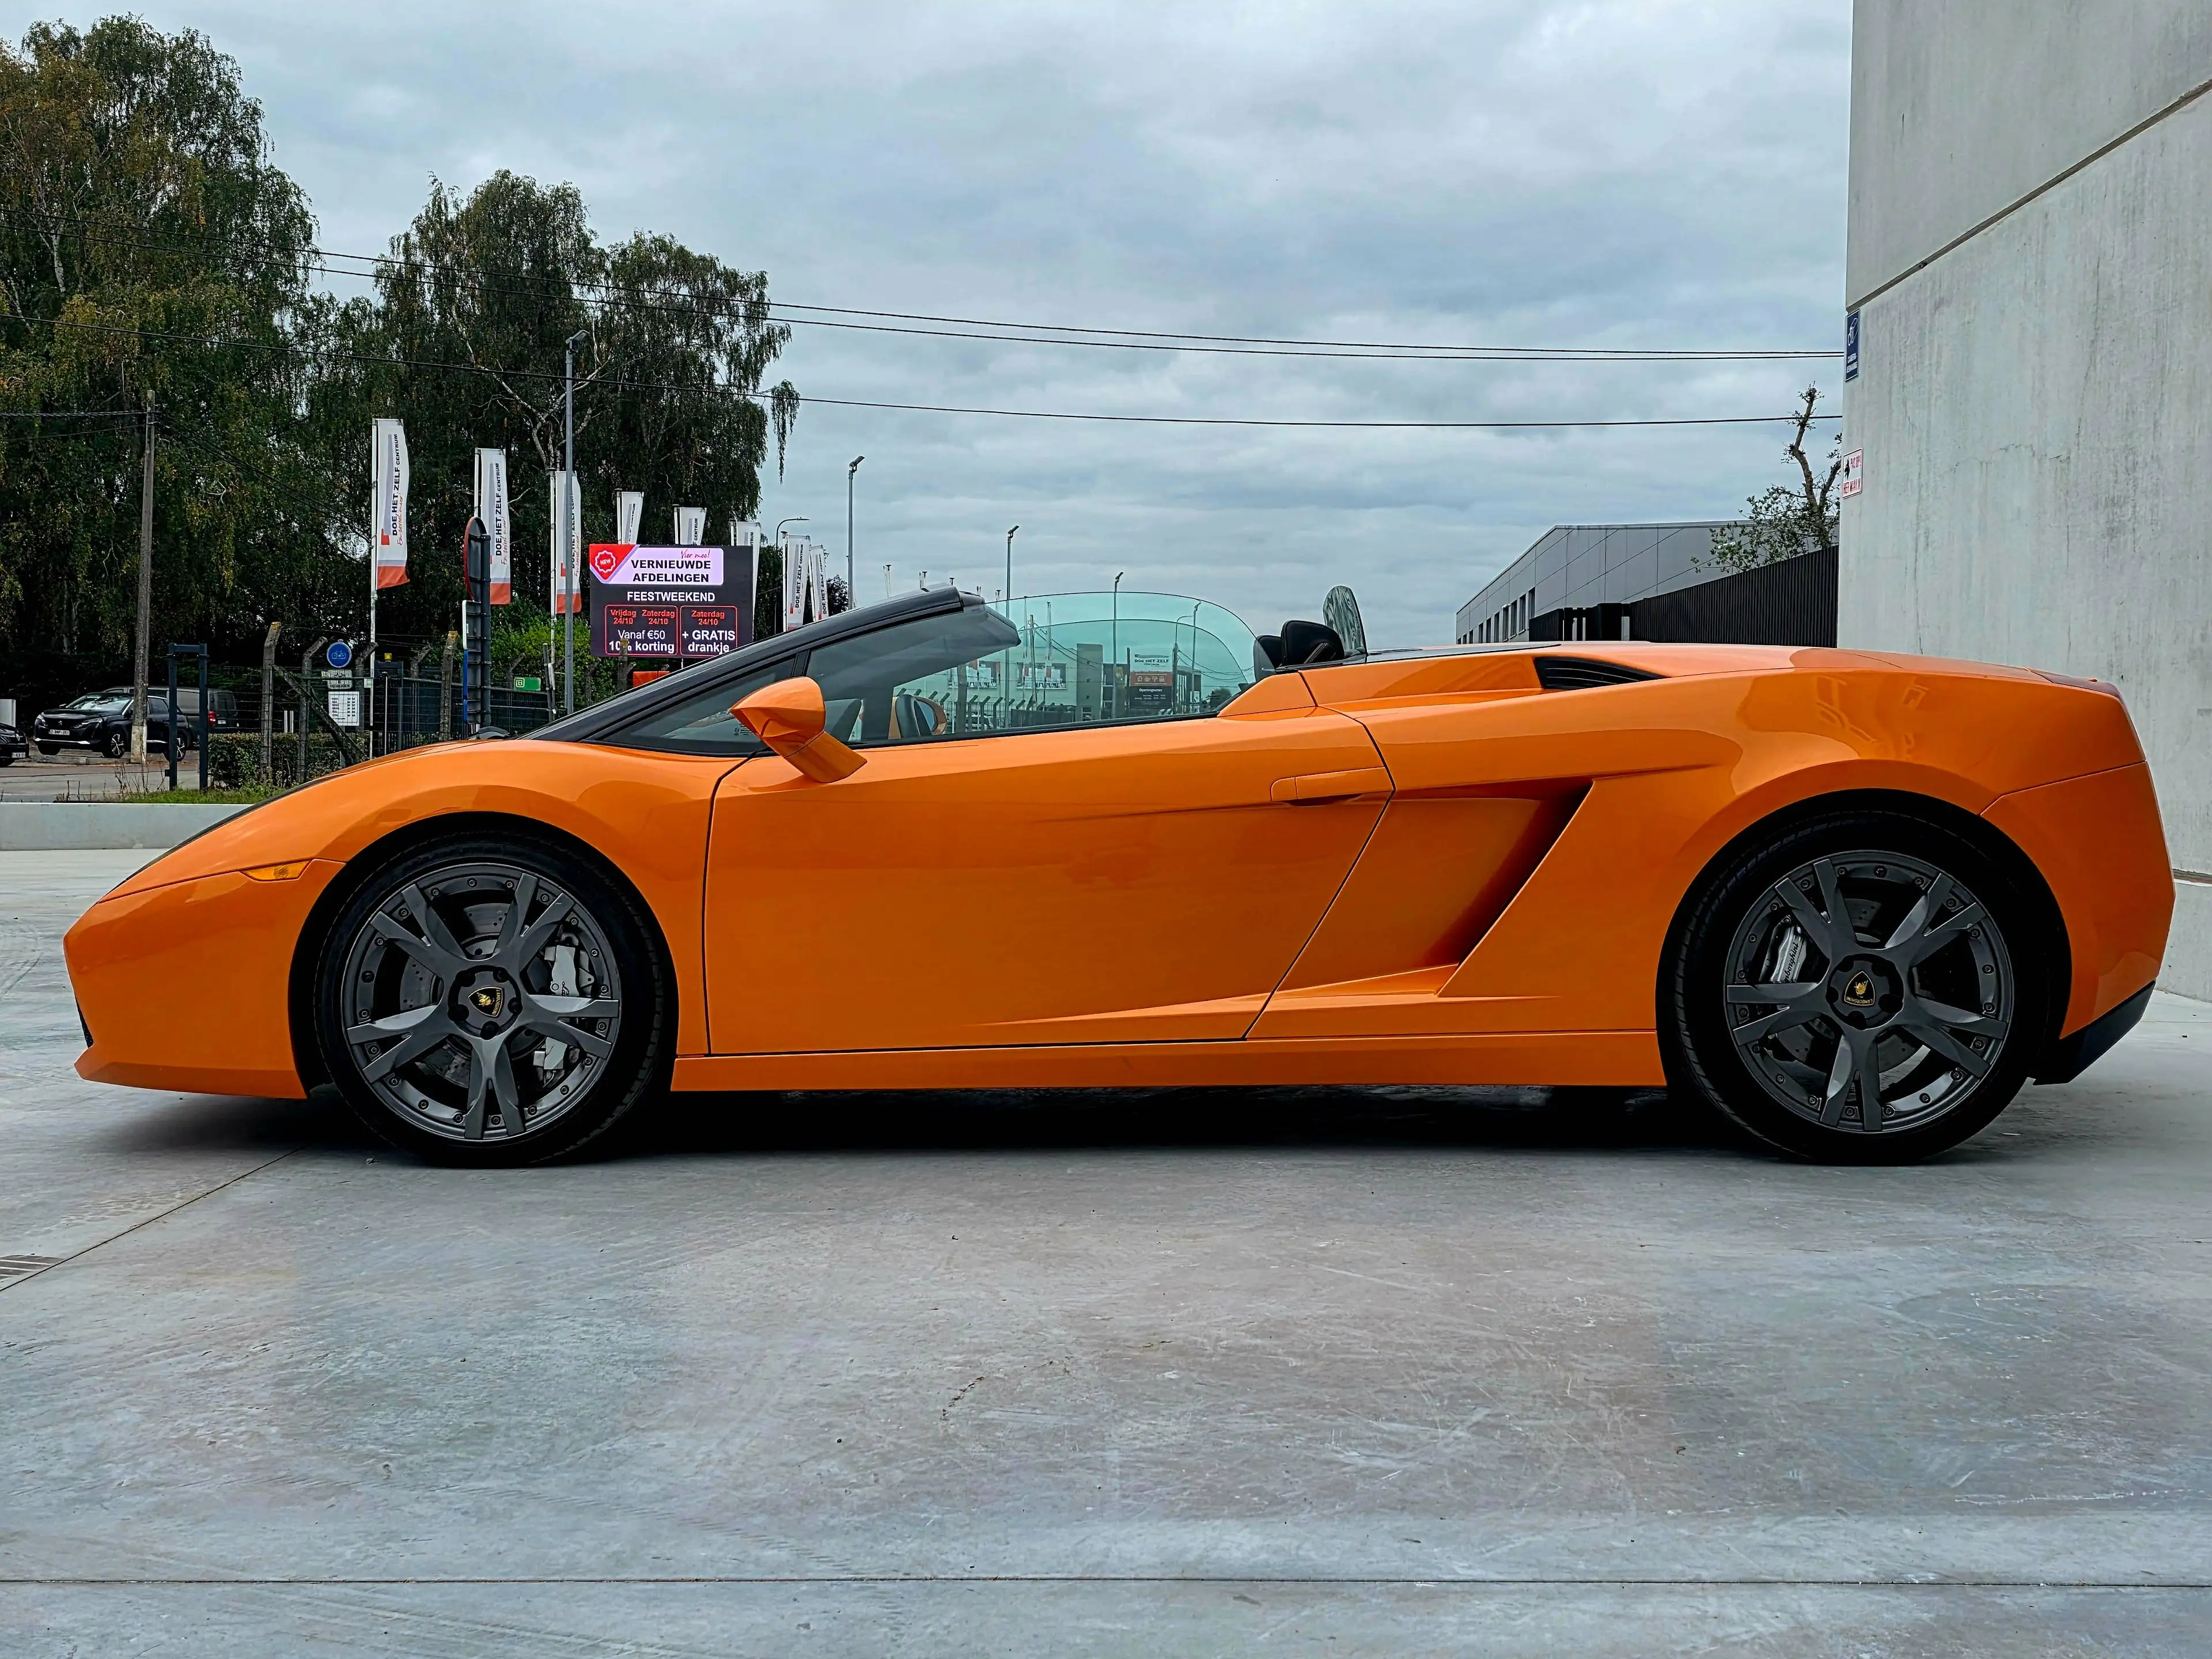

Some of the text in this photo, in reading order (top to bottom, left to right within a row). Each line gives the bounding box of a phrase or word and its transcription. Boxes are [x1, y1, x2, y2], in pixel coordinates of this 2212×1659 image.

[631, 560, 711, 569] VERNIEUWDE
[633, 573, 709, 582] AFDELINGEN
[627, 592, 715, 602] FEESTWEEKEND
[611, 609, 675, 618] Vrijdag Zaterdag
[691, 611, 725, 619] Zaterdag
[618, 630, 665, 639] Vanaf €50
[692, 630, 736, 641] GRATIS
[635, 641, 675, 654] korting
[688, 642, 729, 654] drankje
